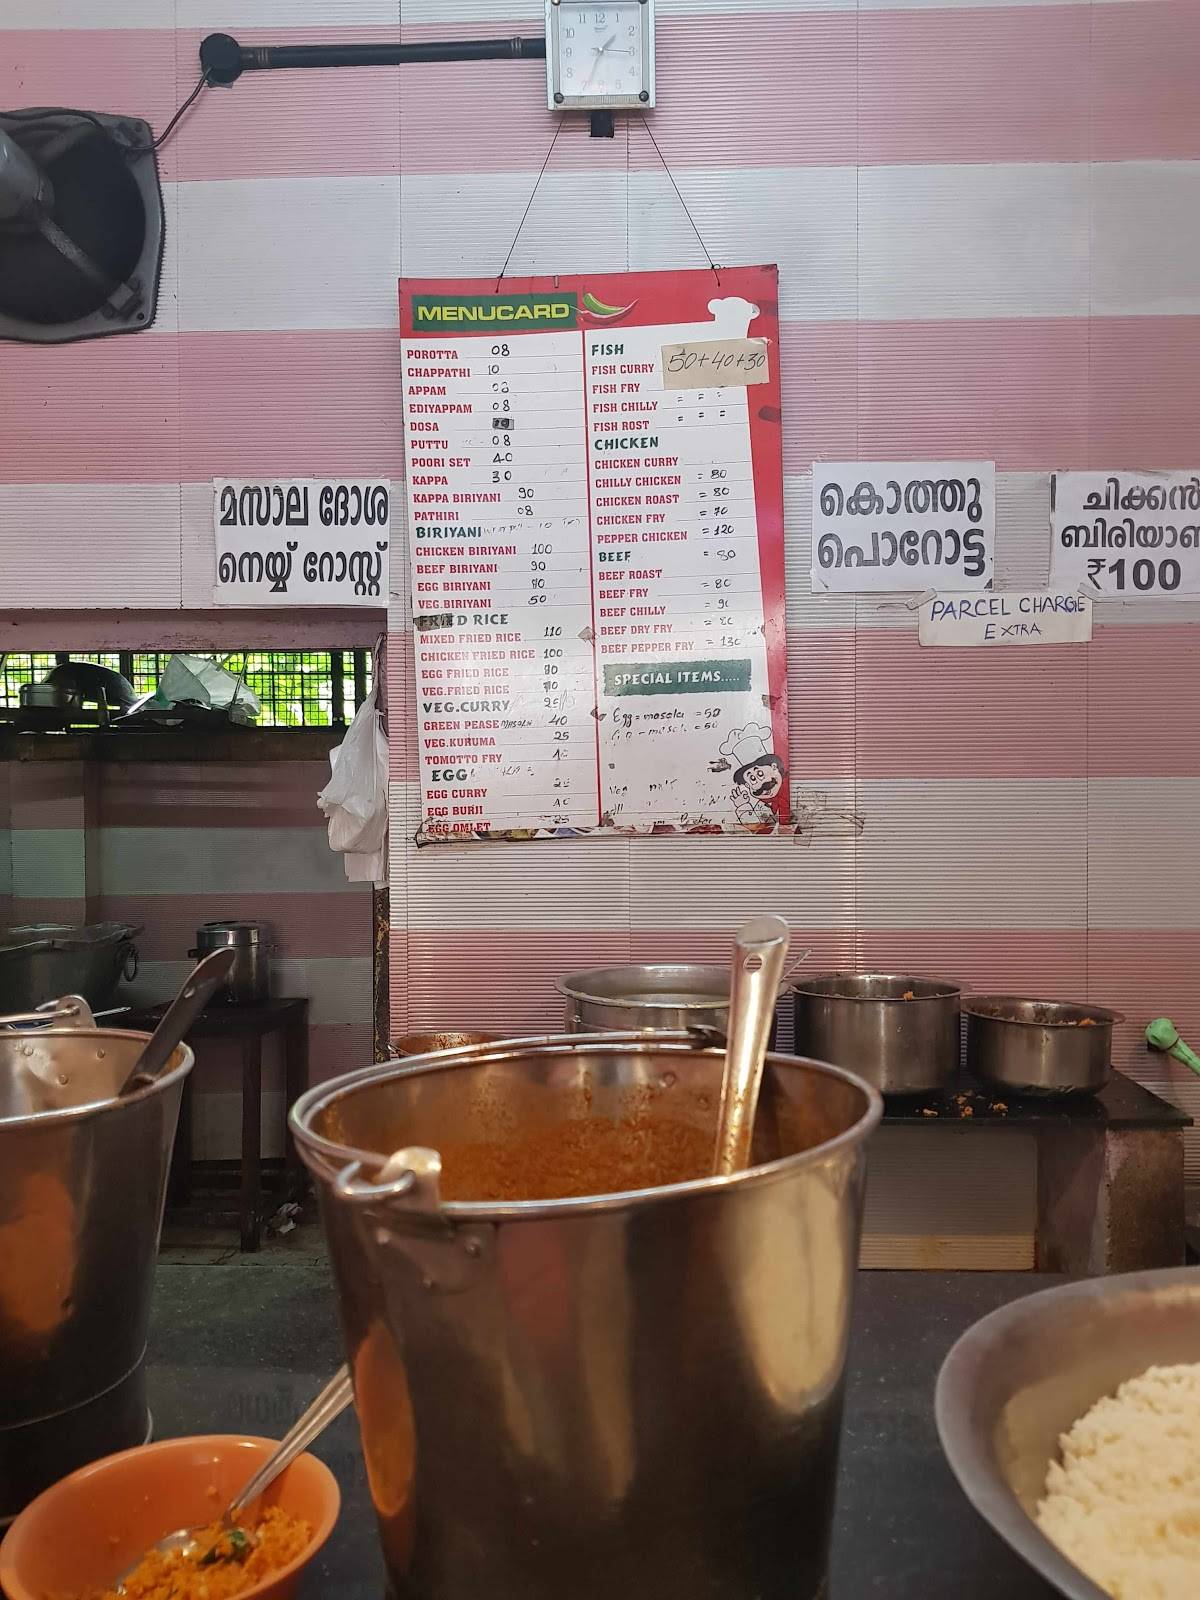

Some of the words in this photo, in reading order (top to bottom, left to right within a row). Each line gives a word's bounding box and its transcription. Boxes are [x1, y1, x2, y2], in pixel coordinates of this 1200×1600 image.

[579, 14, 586, 23] 11
[595, 13, 605, 23] 12
[616, 13, 619, 22] 1
[566, 28, 574, 38] 10
[629, 26, 634, 36] 2
[566, 47, 572, 57] 9
[629, 47, 634, 56] 3
[567, 68, 573, 78] 8
[629, 67, 635, 76] 4
[418, 303, 570, 321] MENUCARD
[407, 350, 458, 359] POROTTA
[491, 344, 509, 356] 08
[592, 344, 624, 355] FISH
[407, 368, 470, 377] CHAPPATHI
[488, 365, 499, 375] 10
[592, 365, 616, 375] FISH
[620, 364, 655, 374] CURRY
[409, 386, 446, 395] APPAM
[592, 384, 616, 394] FISH
[621, 383, 640, 392] FRY
[409, 404, 472, 413] EDIYAPPAM
[492, 399, 510, 412] 08
[593, 403, 617, 413] FISH
[621, 401, 658, 411] CHILLY
[410, 422, 439, 431] DOSA
[594, 422, 618, 432] FISH
[622, 421, 649, 430] ROST
[411, 440, 448, 449] PUTTU
[492, 435, 511, 447] 08
[595, 436, 659, 450] CHICKEN
[412, 458, 444, 467] POORI
[449, 458, 470, 467] SET
[493, 452, 513, 463] 40
[595, 459, 640, 469] CHICKEN
[644, 457, 678, 467] CURRY
[412, 476, 448, 485] KAPPA
[492, 471, 512, 483] 30
[595, 478, 632, 488] CHILLY
[636, 476, 681, 486] CHICKEN
[413, 494, 449, 503] KAPPA
[453, 493, 501, 503] BIRIYANI
[518, 487, 534, 498] 90
[596, 496, 641, 506] CHICKEN
[646, 494, 679, 504] ROAST
[820, 478, 982, 523] കൊത്തു
[220, 486, 308, 526] മസാല
[320, 486, 388, 526] ദോശ
[414, 512, 459, 520] PATHIRI
[518, 505, 533, 515] 08
[597, 515, 642, 525] CHICKEN
[646, 514, 665, 522] FRY
[416, 526, 481, 538] BIRIYANI
[598, 534, 638, 544] PEPPER
[642, 531, 688, 542] CHICKEN
[416, 547, 464, 556] CHICKEN
[469, 546, 516, 555] BIRIYANI
[531, 544, 552, 555] 100
[818, 529, 986, 577] പൊറോട്ട
[599, 551, 631, 562] BEEF
[219, 541, 298, 592] നെയ്യ്
[303, 541, 388, 596] റോസ്റ്റ്
[417, 564, 445, 574] BEEF
[450, 564, 497, 573] BIRIYANI
[599, 571, 625, 580] BEEF
[629, 569, 662, 579] ROAST
[417, 582, 438, 591] EGG
[443, 581, 490, 591] BIRIYANI
[600, 590, 625, 599] BEEF
[630, 589, 648, 597] FRY
[418, 599, 491, 609] VEG.BIRIYANI
[528, 595, 546, 606] 50
[600, 608, 626, 617] BEEF
[630, 606, 666, 616] CHILLY
[931, 598, 1011, 621] PARCEL
[1019, 596, 1085, 613] CHARGE
[419, 614, 467, 627] FRIED
[473, 614, 509, 625] RICE
[420, 634, 454, 644] MIXED
[459, 634, 491, 643] FRIED
[496, 633, 521, 642] RICE
[544, 627, 562, 637] 110
[601, 626, 627, 635] BEEF
[631, 625, 650, 634] DRY
[654, 624, 672, 633] FRY
[984, 623, 1041, 640] EXTRA
[601, 644, 627, 653] BEEF
[632, 642, 672, 652] PEPPER
[676, 641, 694, 651] FRY
[421, 652, 468, 661] CHICKEN
[471, 651, 505, 660] FRIED
[510, 650, 535, 658] RICE
[544, 649, 563, 658] 100
[422, 670, 442, 679] EGG
[447, 669, 479, 678] FRIED
[484, 668, 509, 676] RICE
[614, 672, 672, 685] SPECIAL
[484, 685, 509, 694] RICE
[423, 700, 510, 713] VEG.CURRY
[424, 721, 460, 731] GREEN
[465, 720, 499, 730] PEASE
[549, 715, 568, 725] 40
[553, 731, 569, 740] 25
[425, 755, 477, 765] TOMOTTO
[482, 754, 502, 763] FRY
[432, 769, 468, 782] EGG
[427, 790, 448, 799] EGG
[452, 789, 487, 798] CURRY
[427, 807, 448, 816] EGG
[453, 806, 483, 815] BURJI
[427, 823, 449, 834] EGG
[453, 822, 491, 833] OMLET
